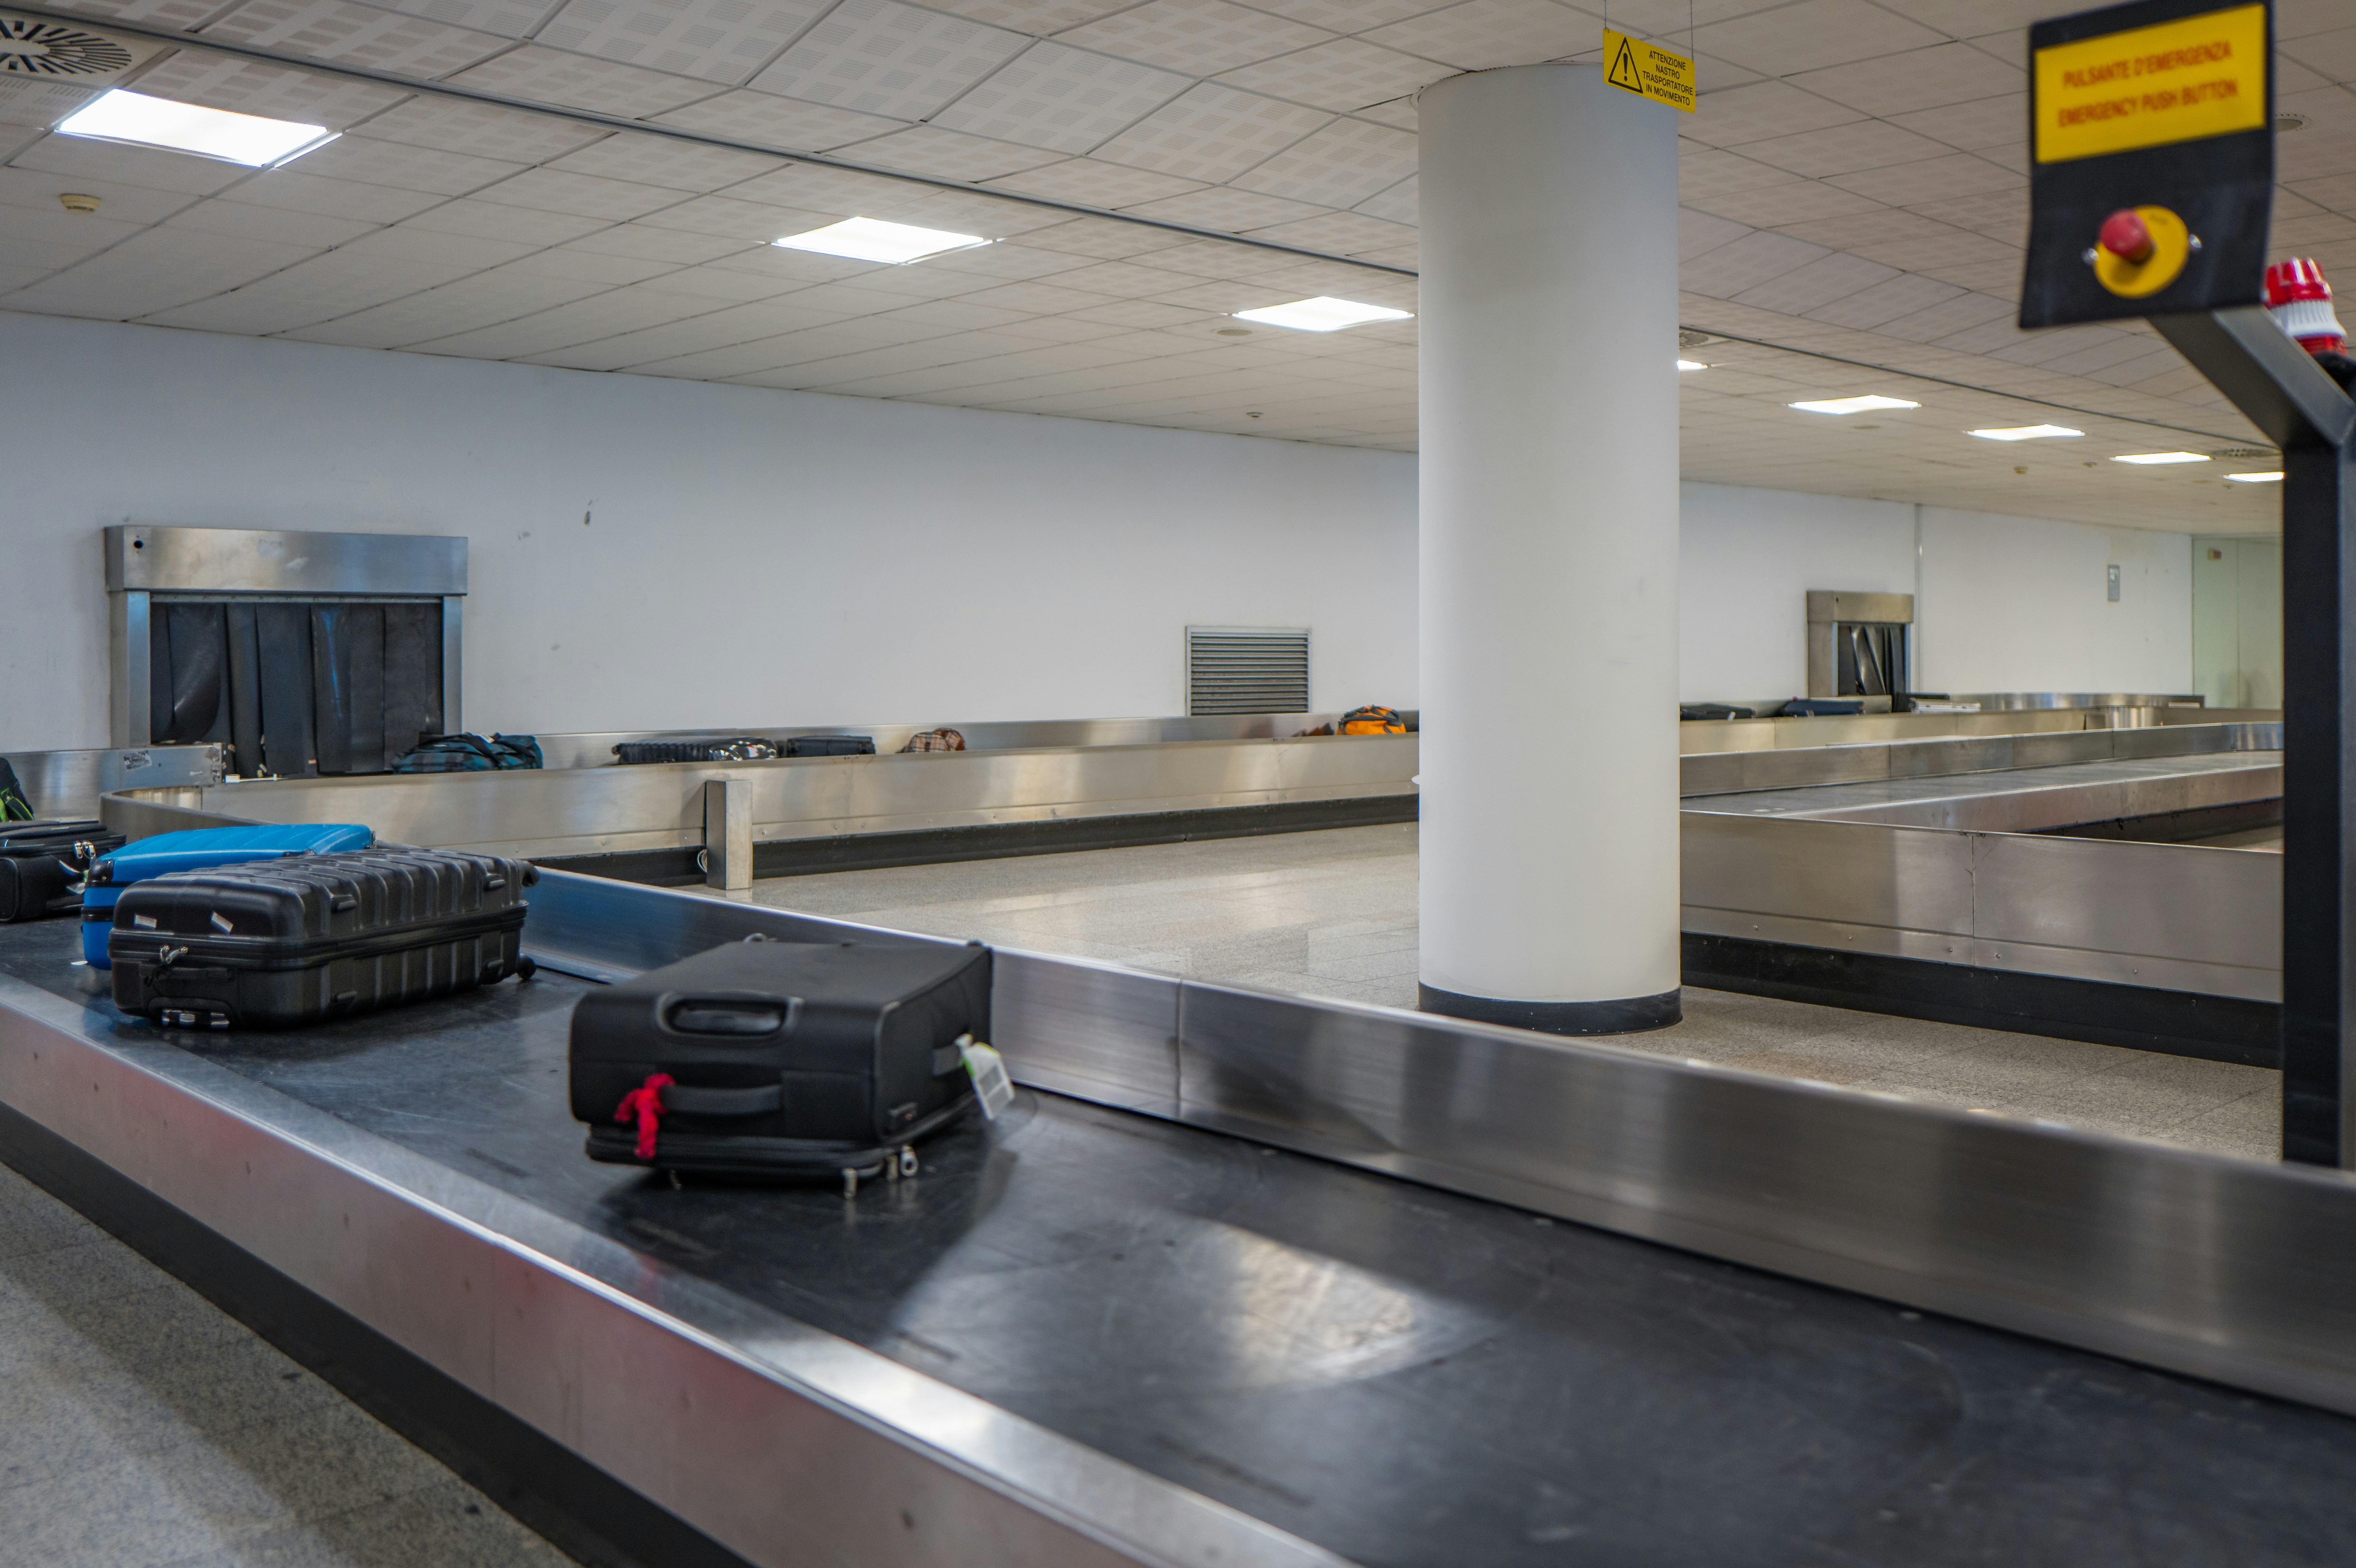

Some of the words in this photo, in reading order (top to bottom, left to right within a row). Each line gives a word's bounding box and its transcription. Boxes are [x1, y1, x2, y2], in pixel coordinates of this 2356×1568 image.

[1649, 50, 1686, 70] ATTENZIONE
[1656, 64, 1680, 79] NASTRO
[1643, 70, 1693, 95] TRASPORTATORE
[2063, 60, 2130, 89] PULSANTE
[1646, 83, 1652, 93] IN
[1654, 86, 1690, 105] MOVIMENTO
[2058, 96, 2137, 128] EMERGENCY
[2142, 90, 2177, 111] PUSH
[2182, 78, 2238, 106] BUTTON
